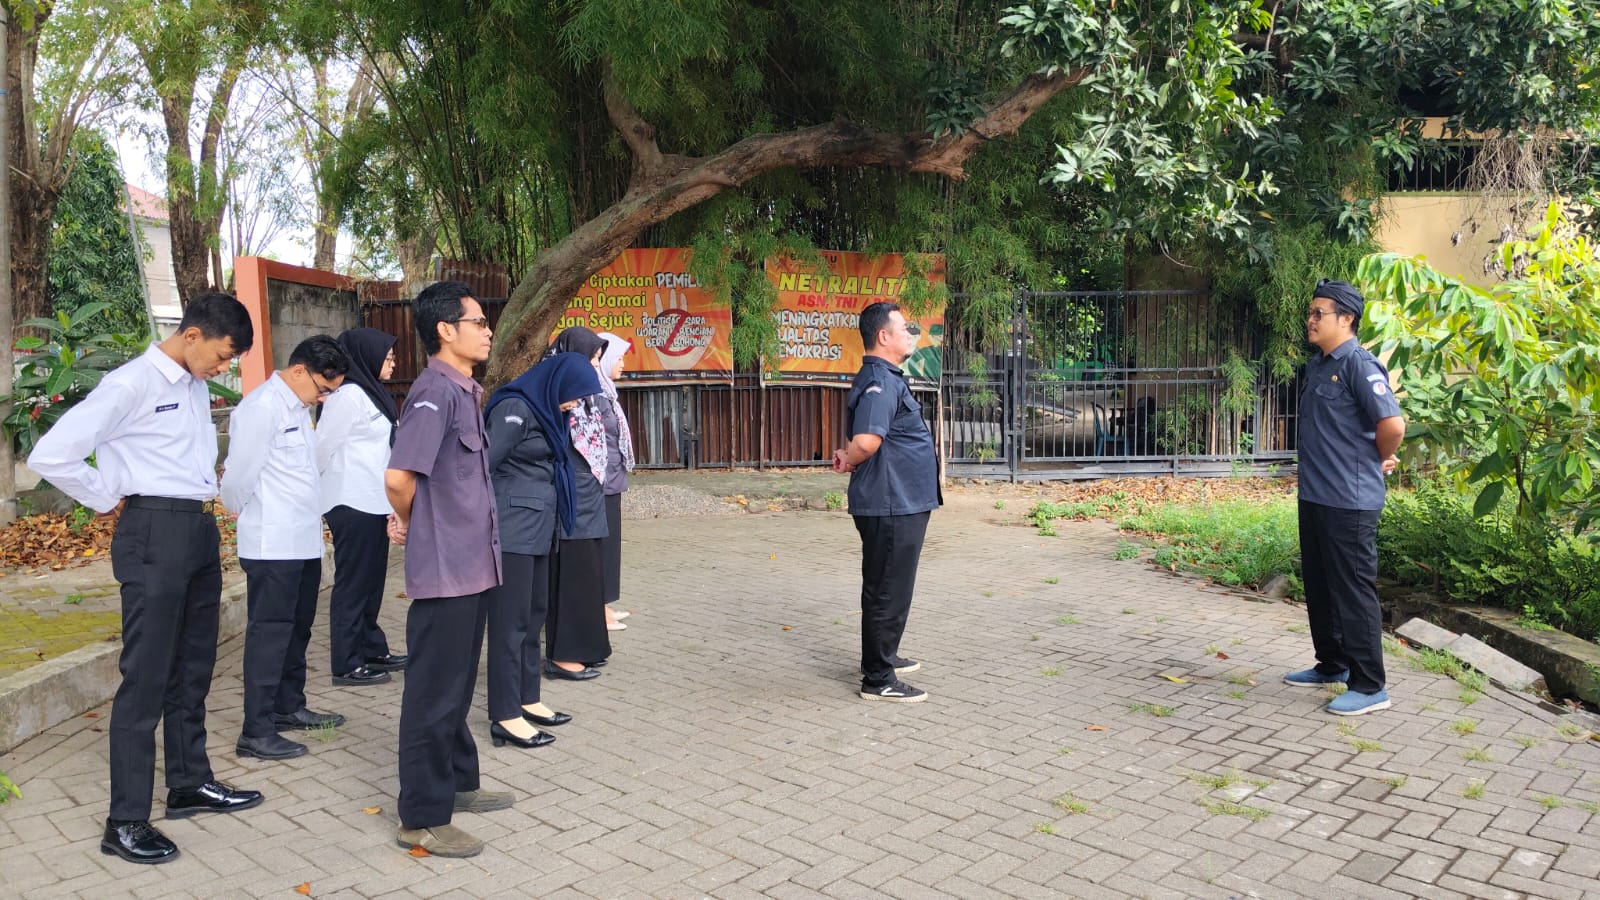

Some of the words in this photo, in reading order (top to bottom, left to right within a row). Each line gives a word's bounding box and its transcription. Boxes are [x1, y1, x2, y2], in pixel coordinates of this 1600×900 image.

[589, 273, 653, 291] Ciptakan
[655, 271, 703, 289] PEMiL
[779, 272, 909, 297] NETRALITA
[597, 291, 647, 308] Damai
[835, 296, 859, 309] TNI
[557, 314, 585, 328] dan
[589, 311, 633, 331] Sejuk
